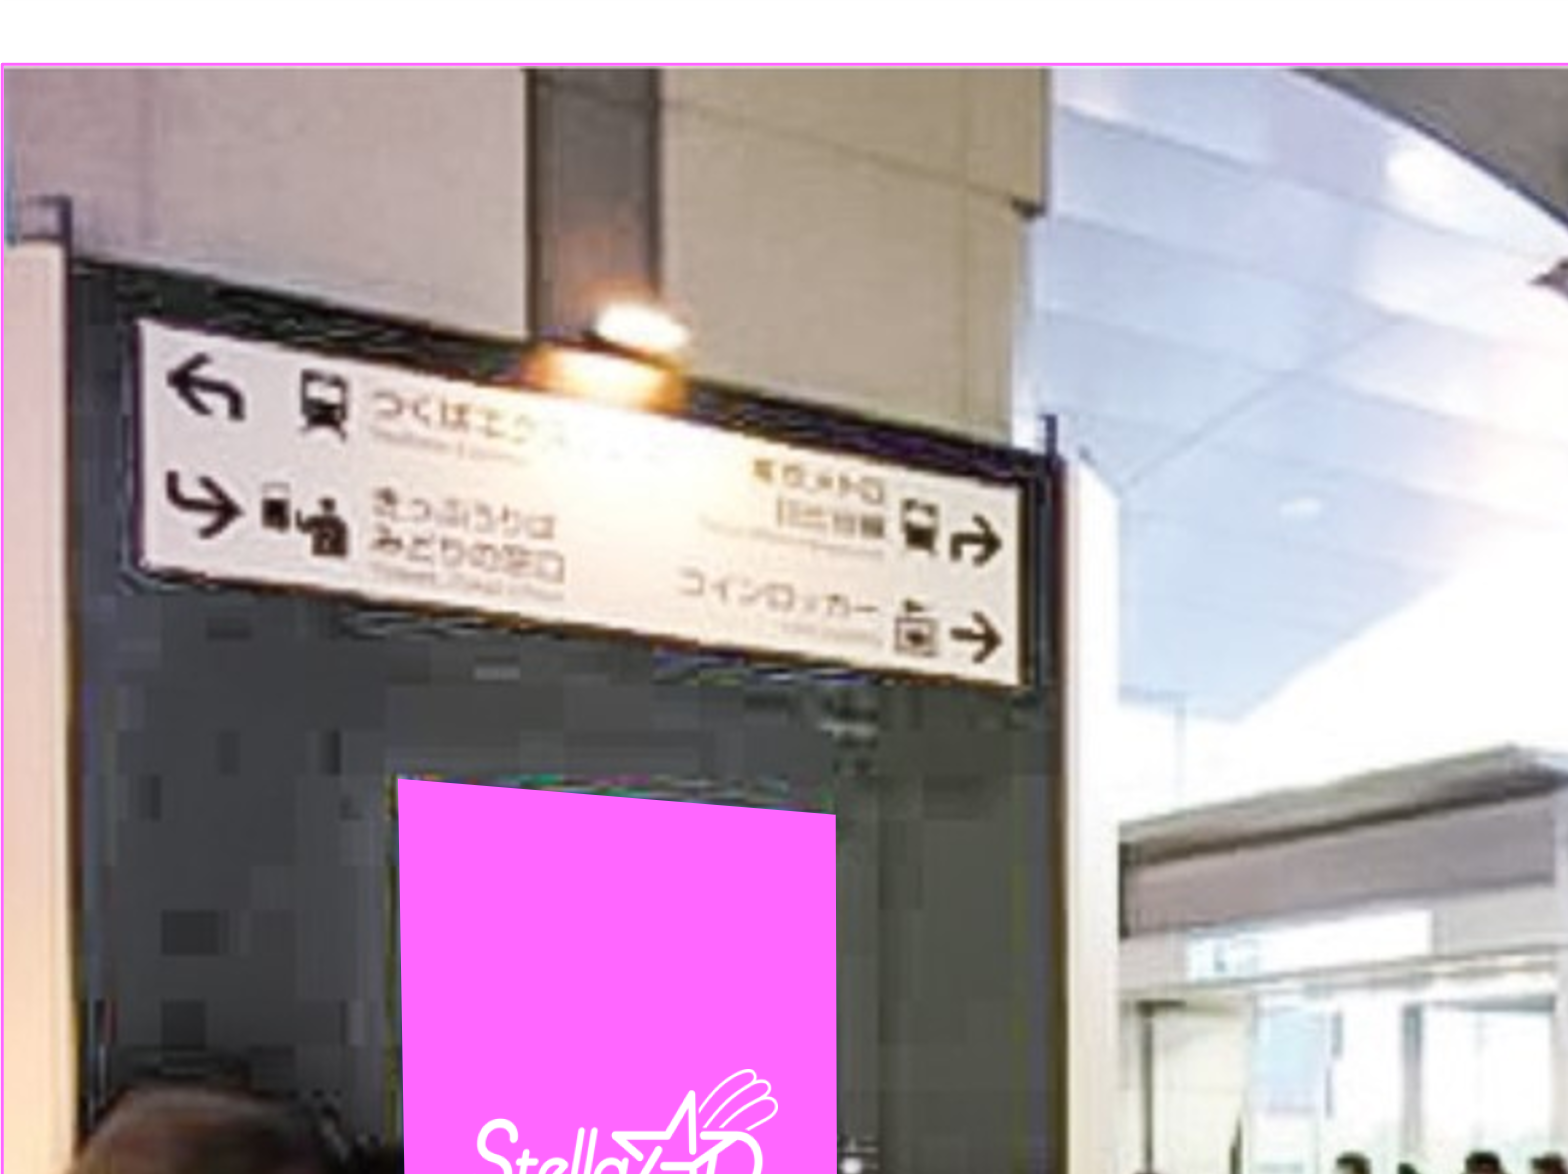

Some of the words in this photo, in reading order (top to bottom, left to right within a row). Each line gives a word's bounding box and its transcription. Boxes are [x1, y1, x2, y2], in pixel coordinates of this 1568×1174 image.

[370, 524, 567, 585] みどりの窓口
[679, 566, 880, 618] コインロッカー
